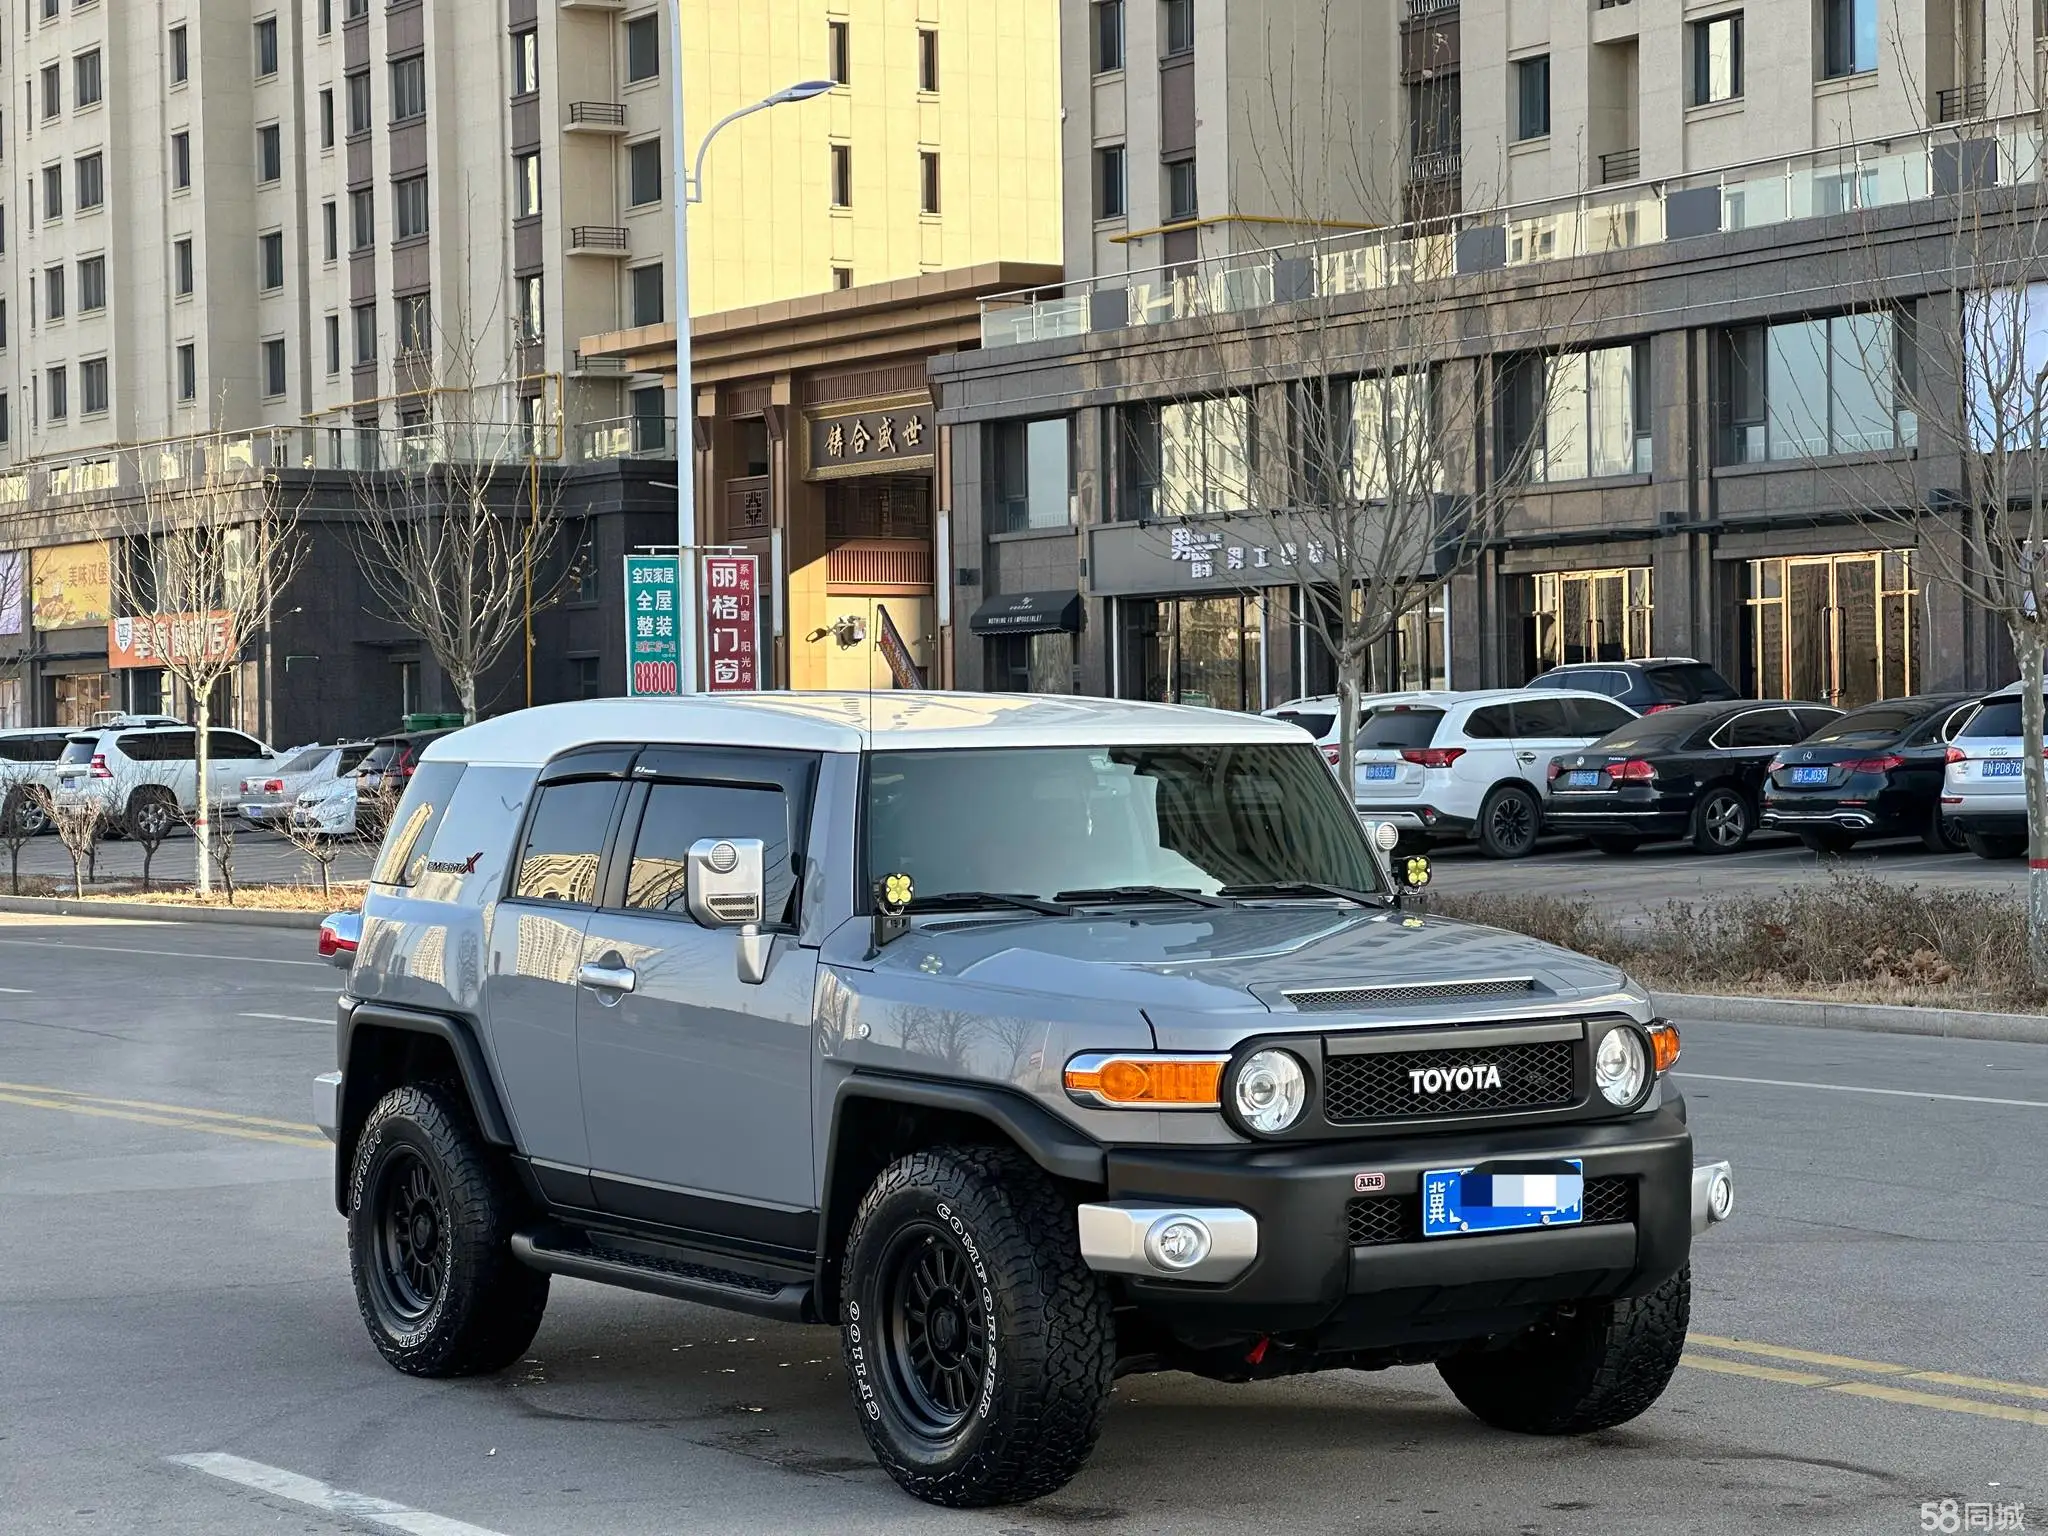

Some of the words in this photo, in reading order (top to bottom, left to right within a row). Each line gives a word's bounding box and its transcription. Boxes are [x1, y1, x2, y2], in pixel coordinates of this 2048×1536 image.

[66, 561, 108, 588] 美味汉堡
[632, 567, 674, 584] 全友家居
[636, 589, 673, 611] 全屋
[636, 615, 673, 637] 整装
[712, 562, 739, 684] 丽格门窗
[634, 660, 677, 694] 88800
[1409, 1064, 1502, 1095] TOYOTA
[1358, 1174, 1383, 1189] ARB
[936, 1203, 997, 1418] COMFORSER
[850, 1301, 880, 1420] CF1100
